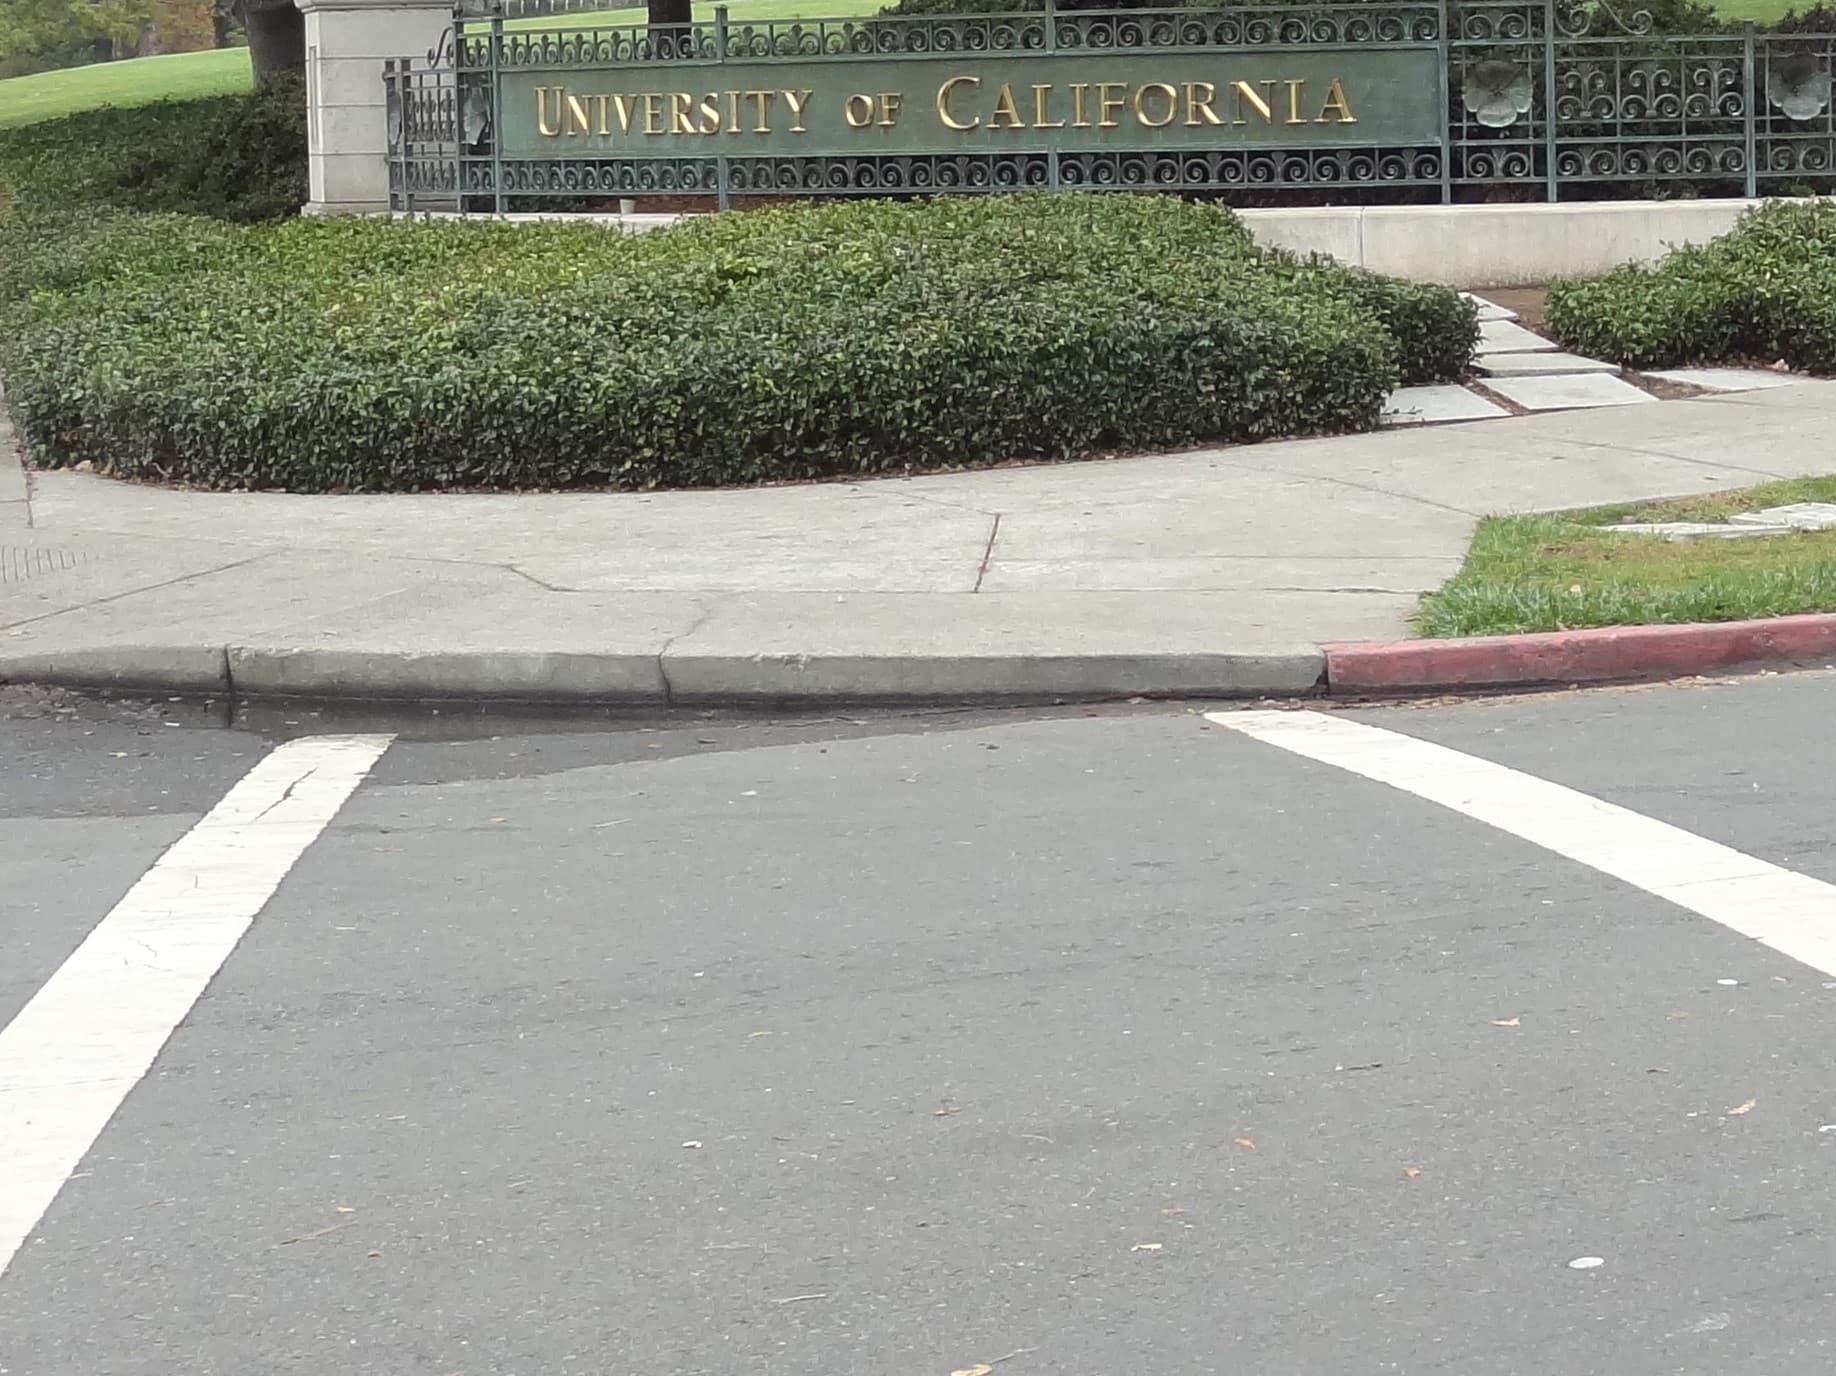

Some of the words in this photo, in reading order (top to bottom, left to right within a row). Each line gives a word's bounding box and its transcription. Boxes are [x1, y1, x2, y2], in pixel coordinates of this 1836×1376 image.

[535, 85, 812, 137] UNIVERSITY
[845, 92, 902, 127] OF
[936, 76, 1358, 130] CALIFORNIA
